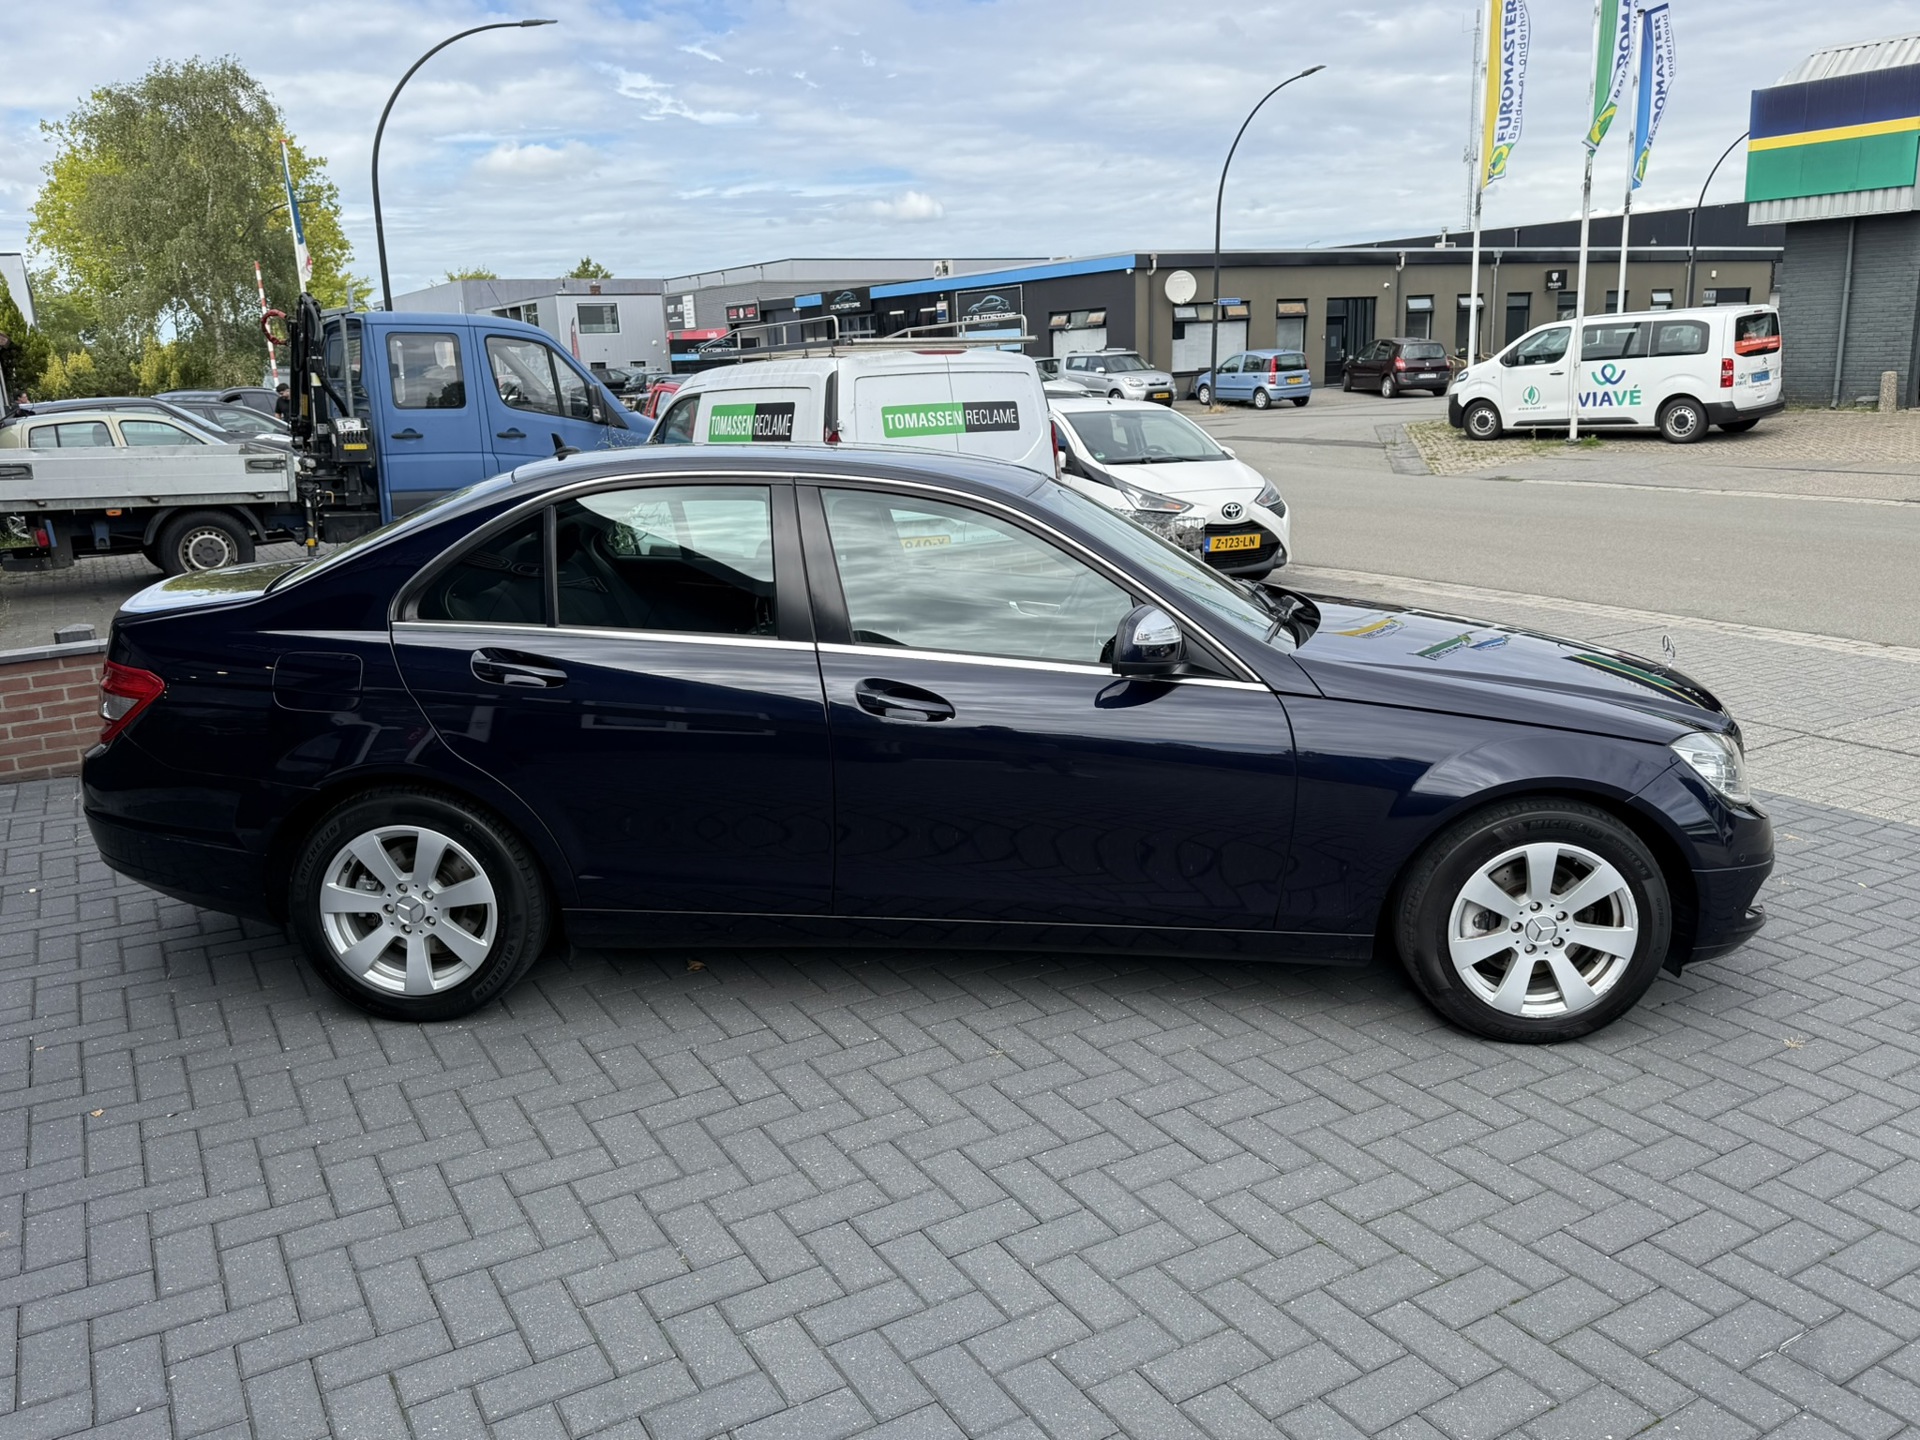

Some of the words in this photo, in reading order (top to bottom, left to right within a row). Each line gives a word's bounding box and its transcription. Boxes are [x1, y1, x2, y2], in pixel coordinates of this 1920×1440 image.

[1661, 14, 1674, 78] onderhoud
[1497, 0, 1517, 142] EUROMASTER
[1578, 384, 1642, 407] VIAVÉ
[711, 415, 753, 435] TOMASSEN
[753, 414, 792, 436] RECLAME
[885, 410, 963, 429] TOMASSEN
[965, 408, 1017, 425] RECLAME
[1215, 536, 1256, 549] Z-123-LN
[300, 824, 338, 880] MICHELIN
[475, 943, 515, 998] MICHELIN
